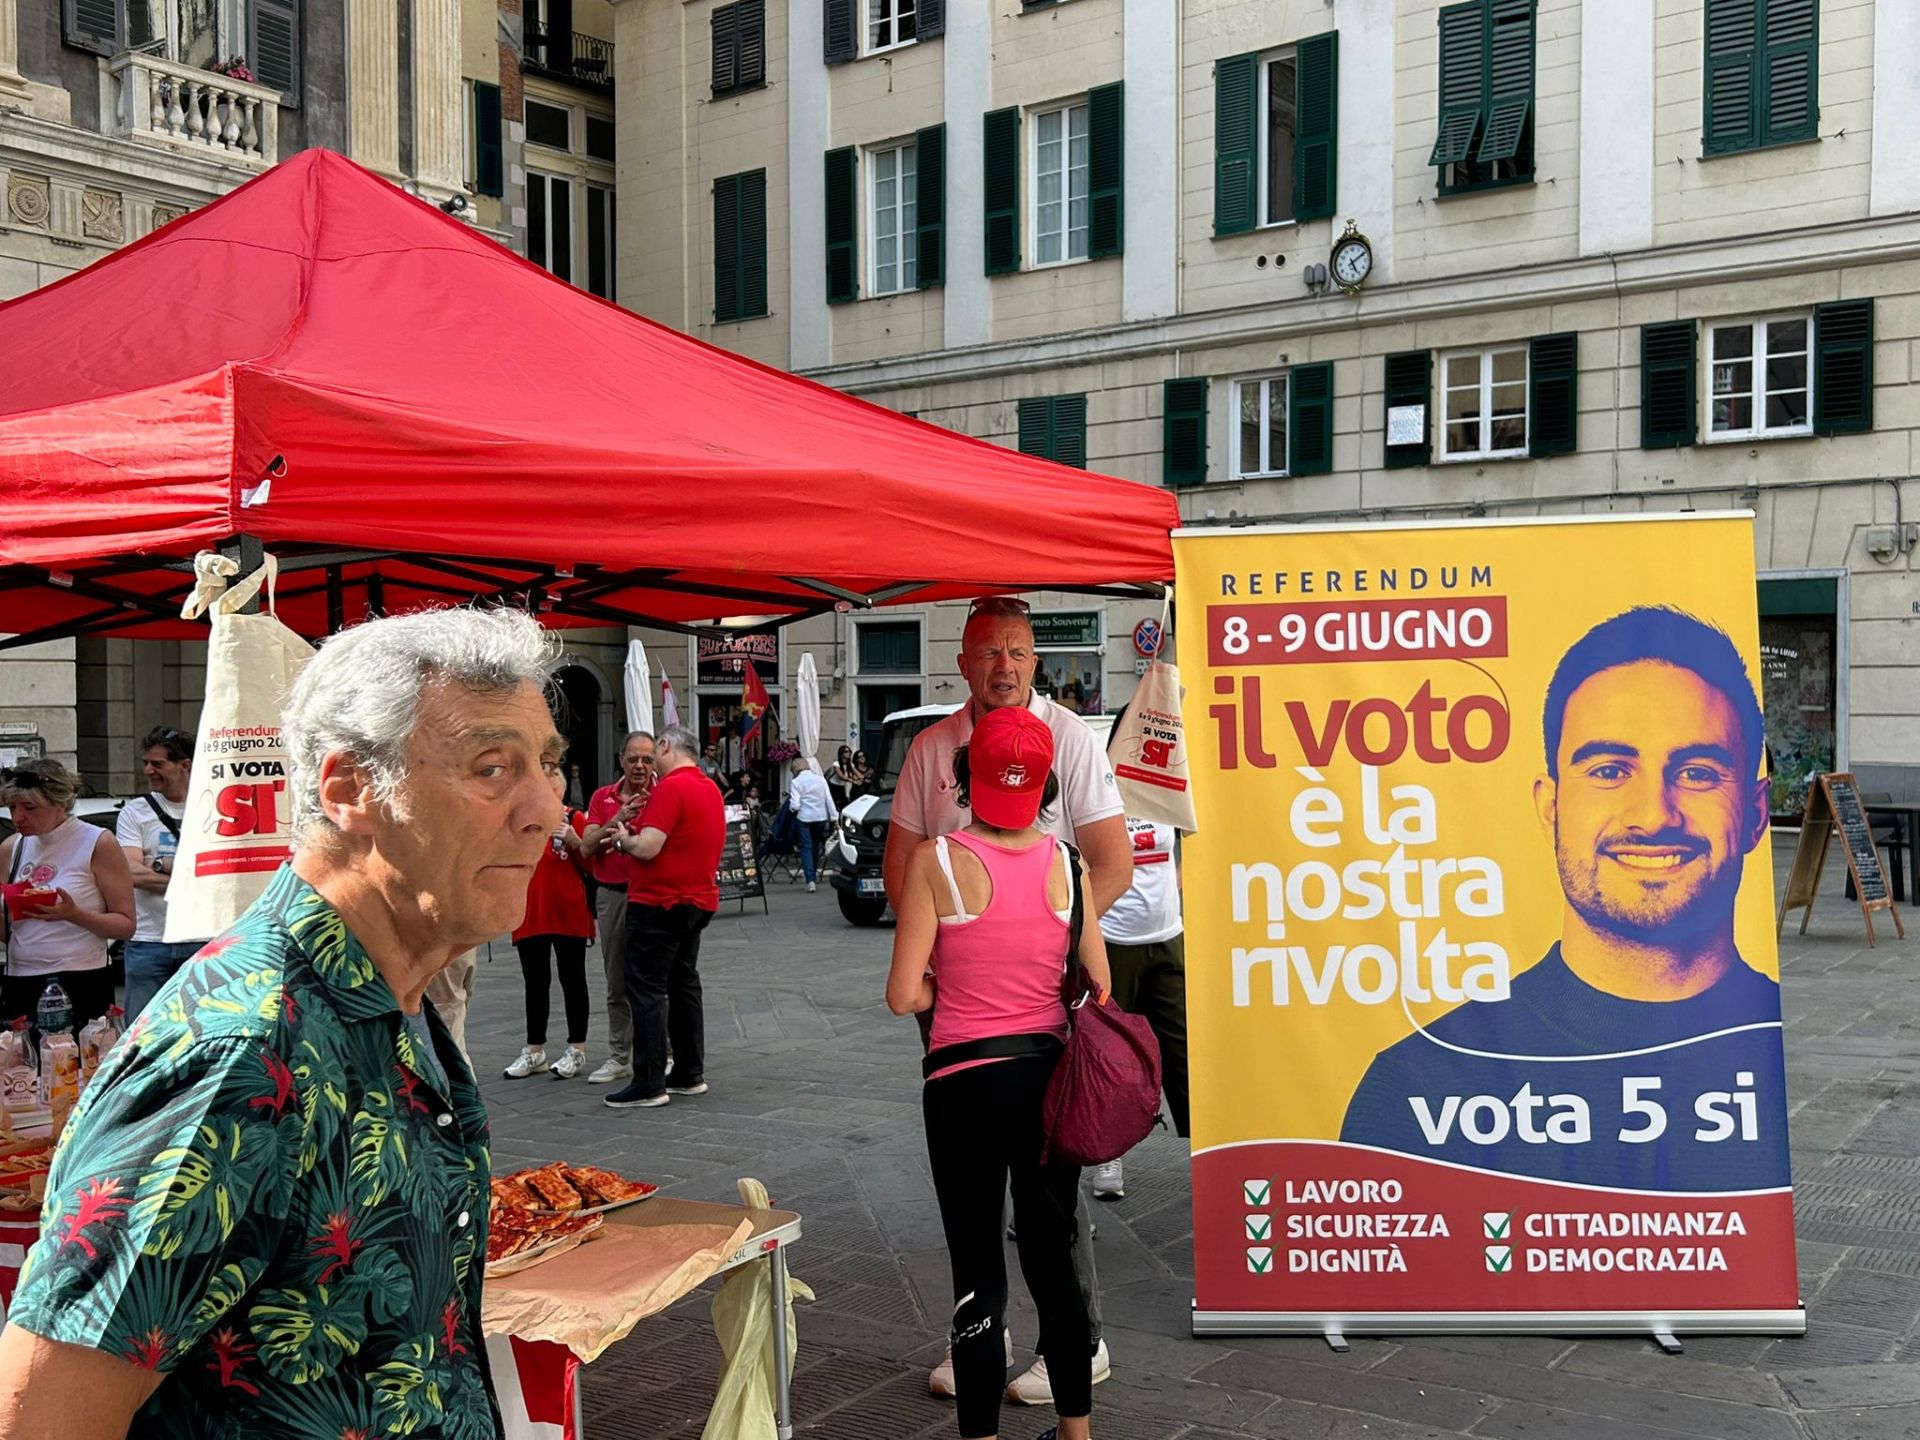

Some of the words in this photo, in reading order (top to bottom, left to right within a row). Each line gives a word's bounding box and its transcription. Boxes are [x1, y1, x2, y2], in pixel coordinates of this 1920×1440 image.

[1221, 566, 1492, 596] REFERENDUM
[1053, 616, 1090, 627] Souvenir
[1314, 607, 1493, 652] GIUGNO
[1767, 662, 1786, 670] ANNI
[1153, 728, 1177, 742] VOTA
[1209, 675, 1276, 770] il
[1283, 678, 1510, 767] voto
[221, 737, 265, 753] giugno
[211, 764, 224, 779] SI
[230, 761, 285, 777] VOTA
[1290, 766, 1344, 847] è
[1361, 764, 1437, 845] la
[1135, 823, 1155, 831] VOTA
[1231, 844, 1504, 922] nostra
[1231, 921, 1511, 1007] rivolta
[1408, 1081, 1591, 1145] vota
[1618, 1076, 1667, 1143] 5
[1694, 1071, 1758, 1142] si
[1285, 1179, 1403, 1204] LAVORO
[1286, 1213, 1450, 1238] SICUREZZA
[1524, 1211, 1747, 1237] CITTADINANZA
[1288, 1243, 1408, 1272] DIGNITÀ
[1526, 1247, 1728, 1272] DEMOCRAZIA
